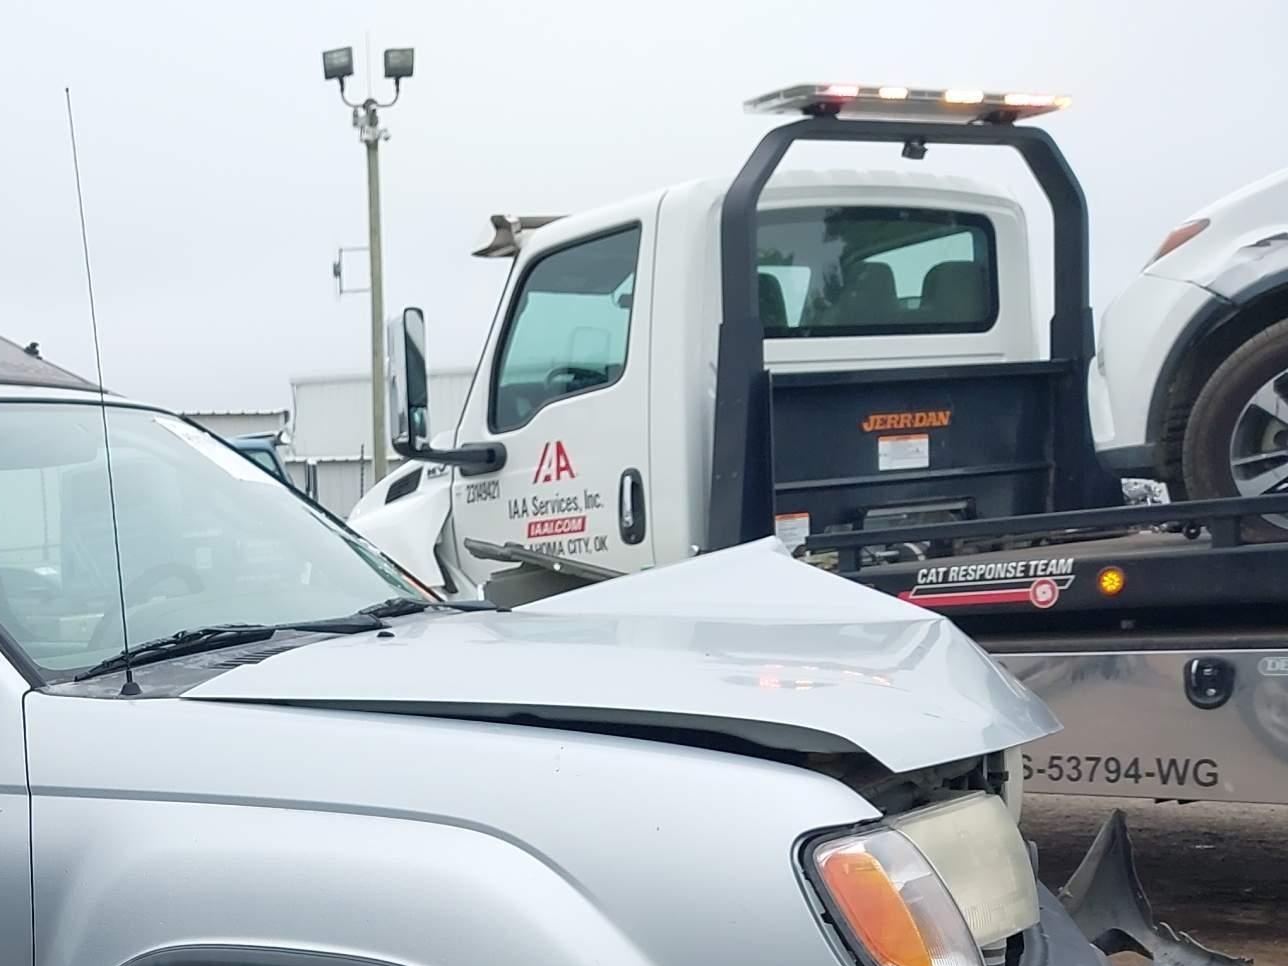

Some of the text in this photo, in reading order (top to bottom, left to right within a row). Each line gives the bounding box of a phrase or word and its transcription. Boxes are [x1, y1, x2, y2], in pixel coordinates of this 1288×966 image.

[509, 490, 605, 519] IAA Services, Inc.
[593, 535, 609, 551] OK
[917, 558, 1075, 584] CAT RESPONSE TEAM
